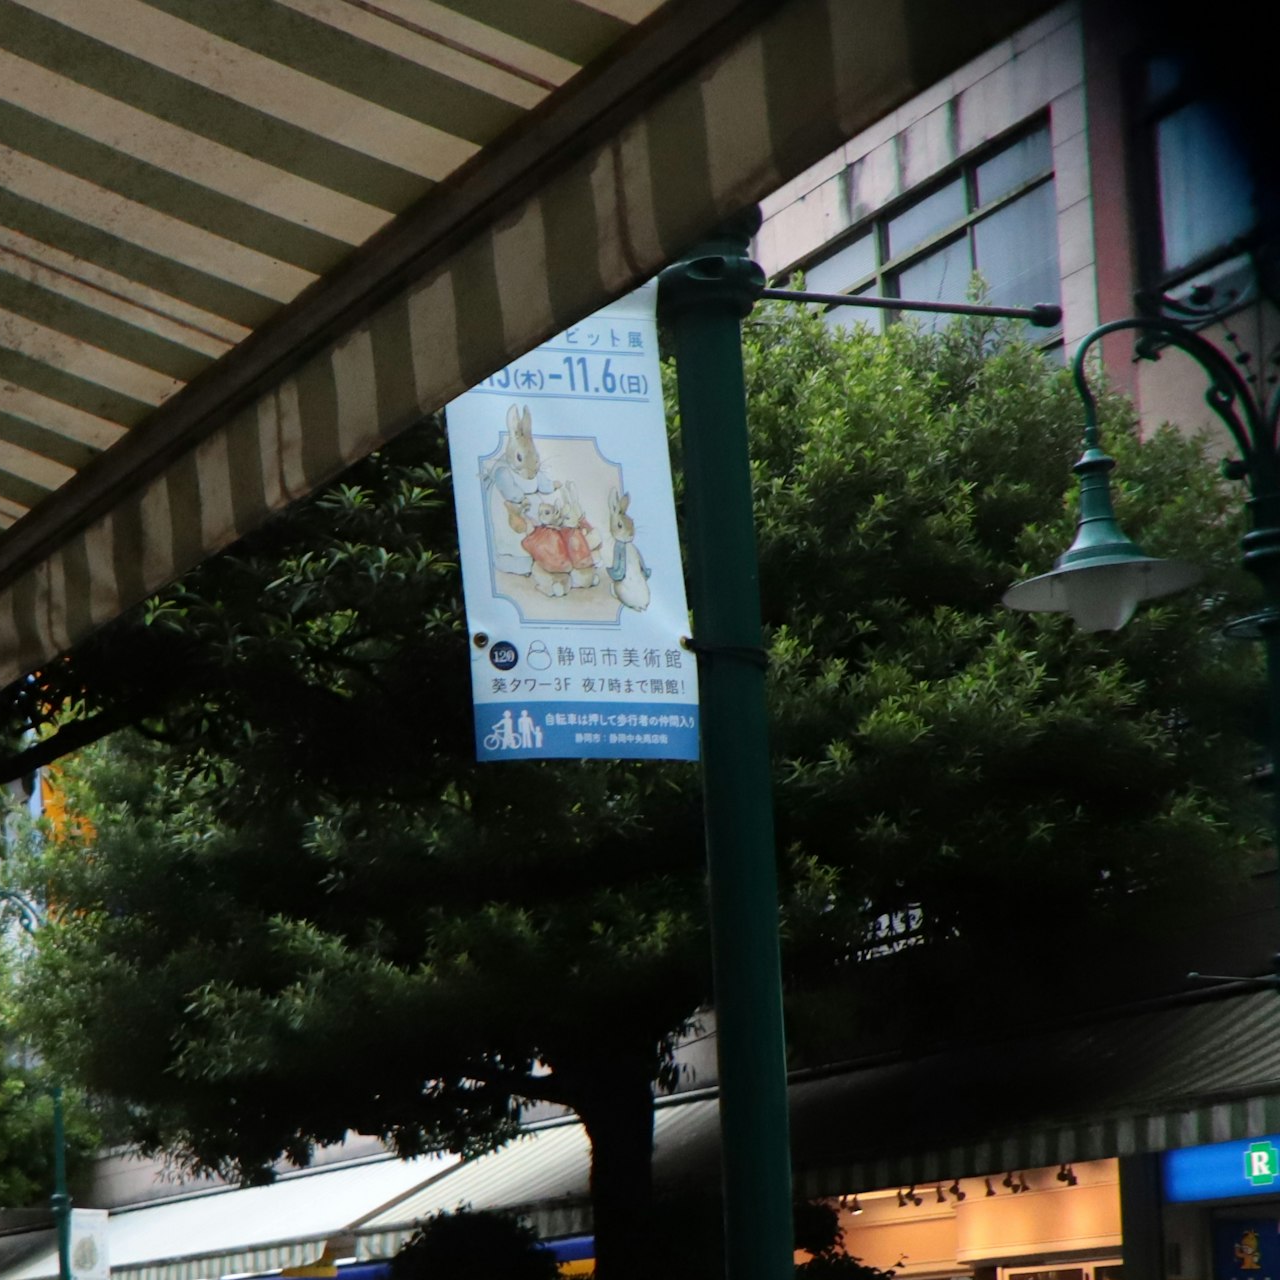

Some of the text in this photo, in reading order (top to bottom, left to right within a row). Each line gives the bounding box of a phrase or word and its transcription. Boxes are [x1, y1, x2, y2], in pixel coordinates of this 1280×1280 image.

[491, 648, 517, 664] 120
[557, 646, 683, 669] 静岡市美術館
[491, 677, 572, 694] 葵タワー3F
[544, 712, 696, 729] 自転車は押して歩行者の仲間入り
